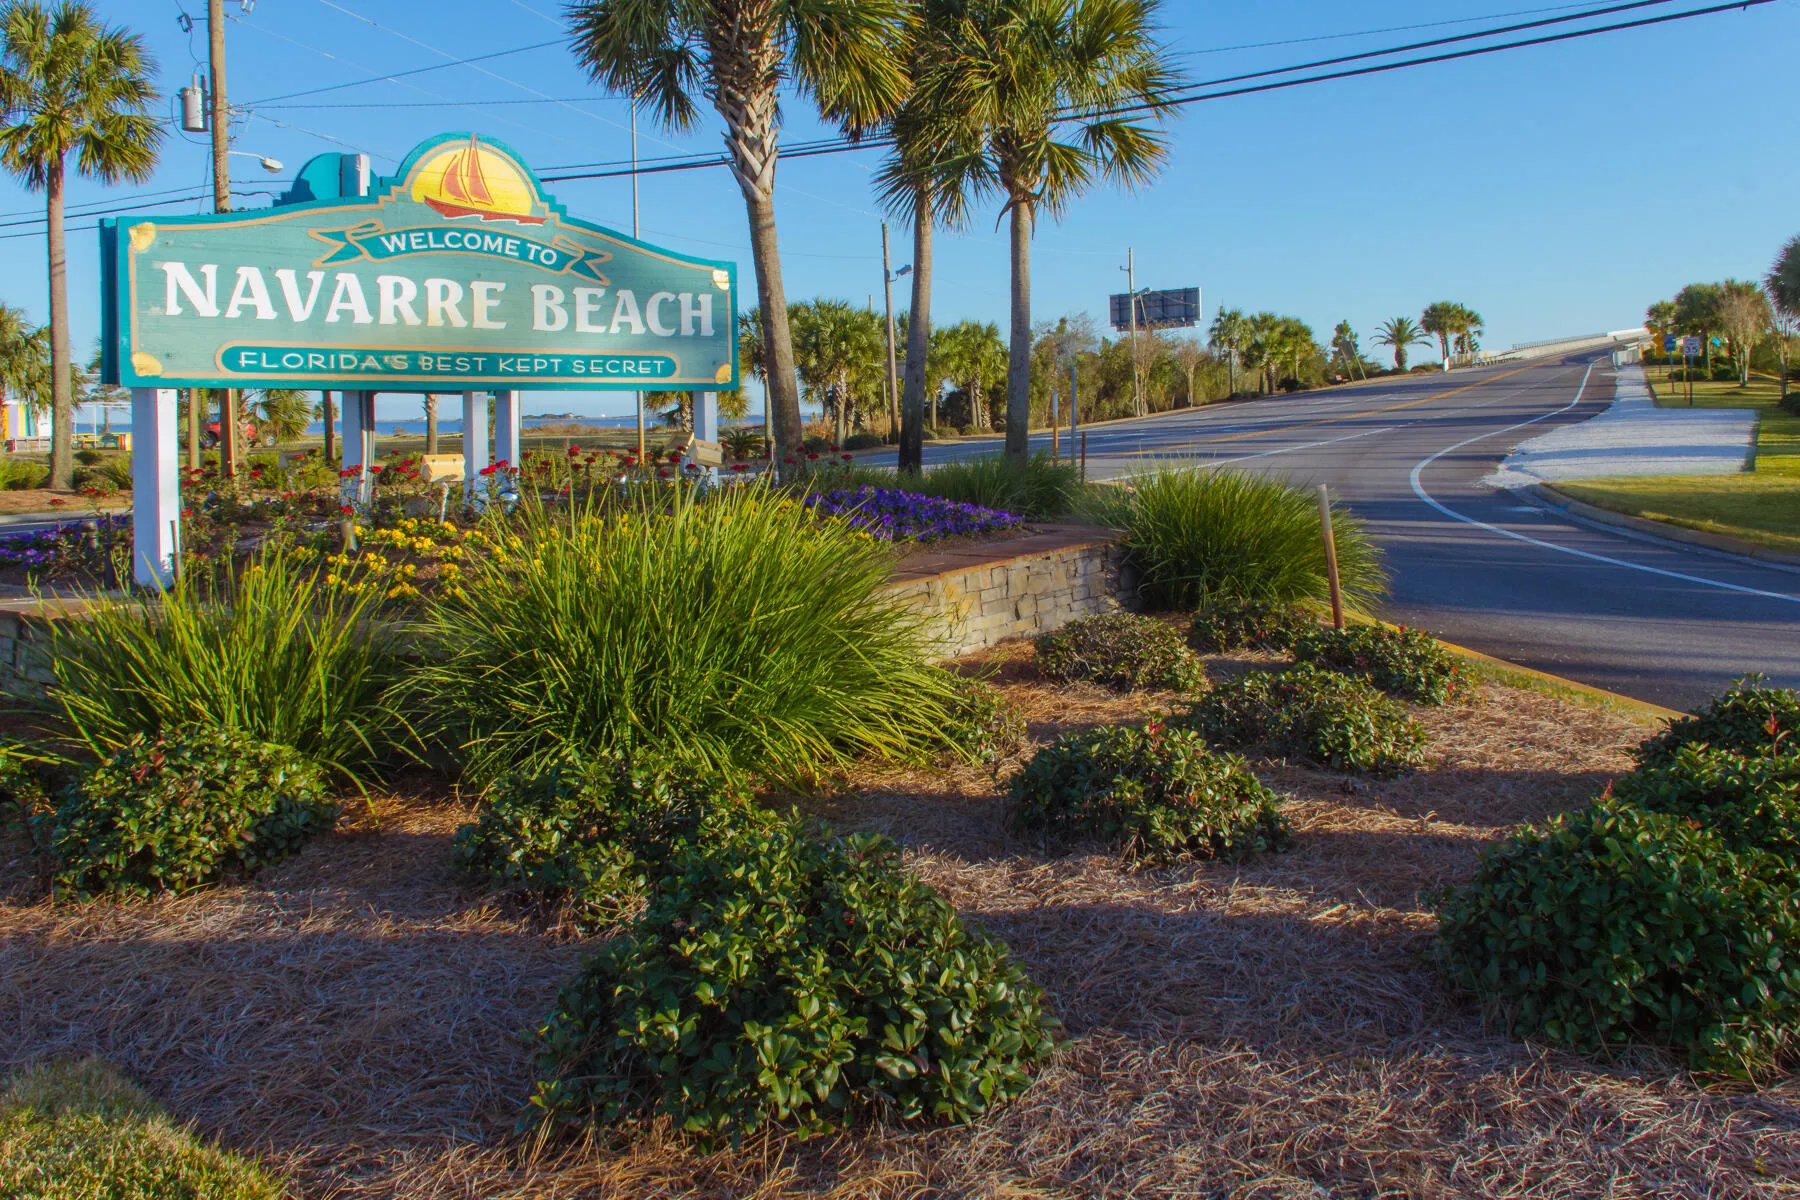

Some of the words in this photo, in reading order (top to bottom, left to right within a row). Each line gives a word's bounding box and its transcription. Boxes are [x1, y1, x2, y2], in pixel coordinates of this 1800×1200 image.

[380, 231, 520, 257] WELCOME
[526, 242, 557, 265] TO
[161, 261, 508, 329] NAVARRE
[530, 283, 715, 337] BEACH
[238, 351, 408, 371] FLORIDA'S
[420, 356, 487, 373] BEST
[498, 356, 563, 374] KEPT
[571, 358, 665, 375] SECRET
[1684, 346, 1698, 354] 35
